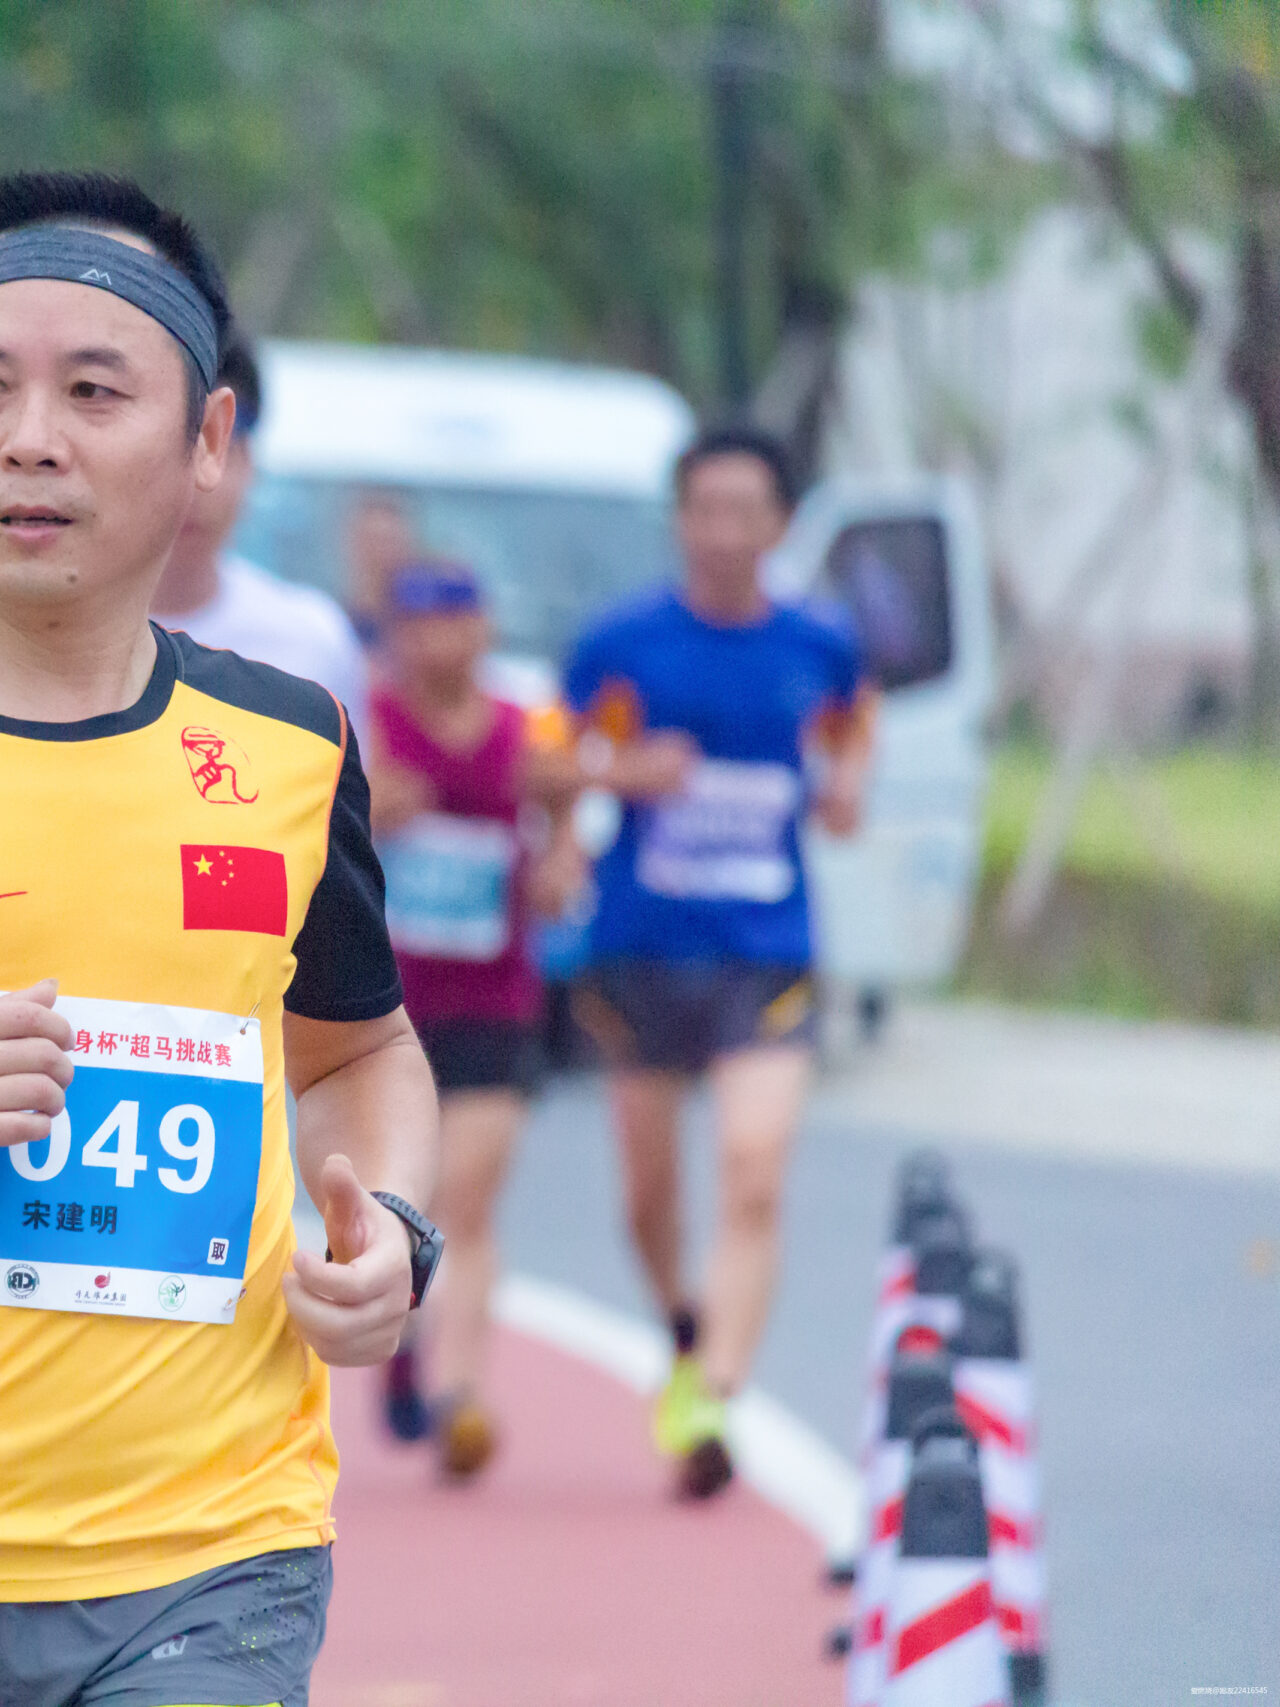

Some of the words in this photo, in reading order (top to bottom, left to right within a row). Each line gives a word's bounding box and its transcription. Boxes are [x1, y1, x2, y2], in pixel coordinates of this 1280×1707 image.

[22, 1199, 119, 1235] 宋建明
[211, 1241, 227, 1262] 取
